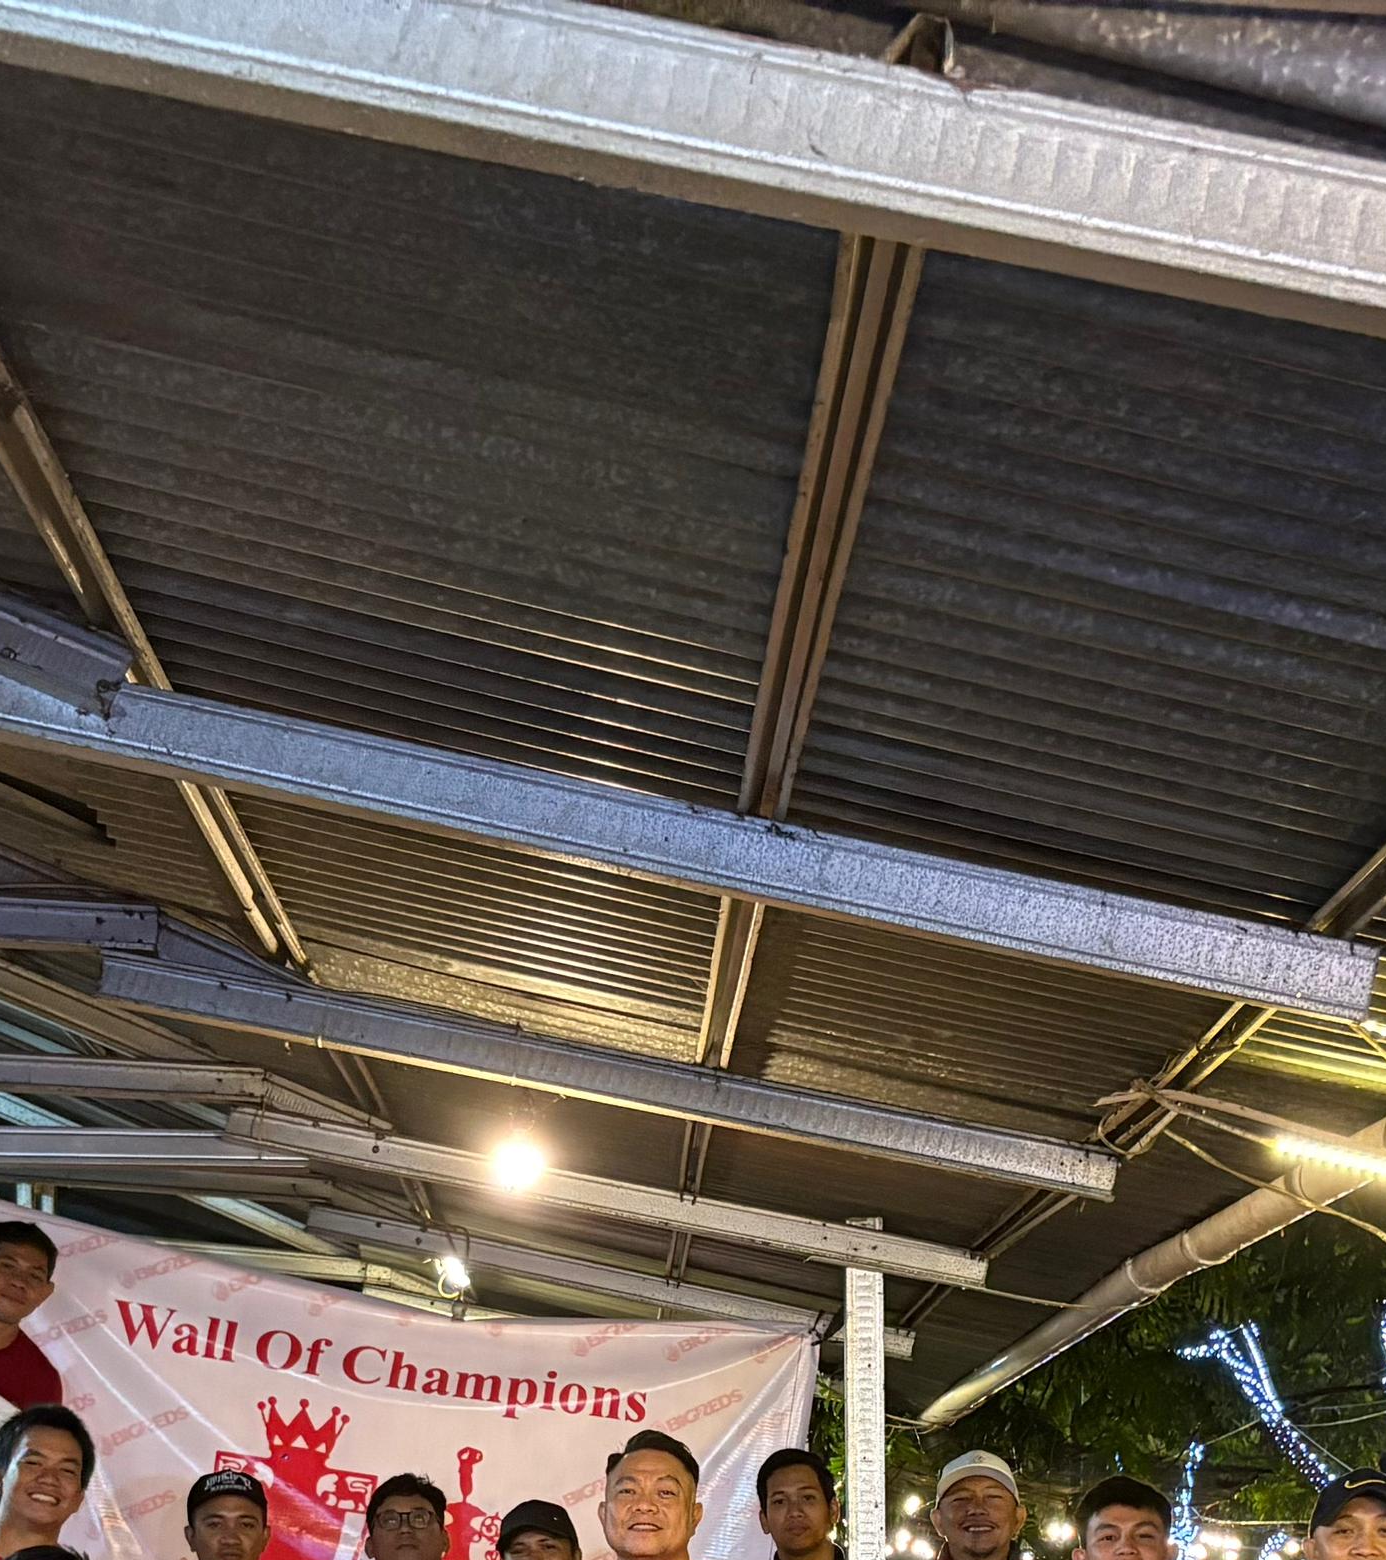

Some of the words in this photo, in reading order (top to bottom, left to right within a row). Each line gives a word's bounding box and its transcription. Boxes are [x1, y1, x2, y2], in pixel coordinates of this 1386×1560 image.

[115, 1300, 238, 1362] Wall
[256, 1330, 333, 1376] Of
[342, 1346, 647, 1422] Champions
[665, 1389, 743, 1432] BIGREDS
